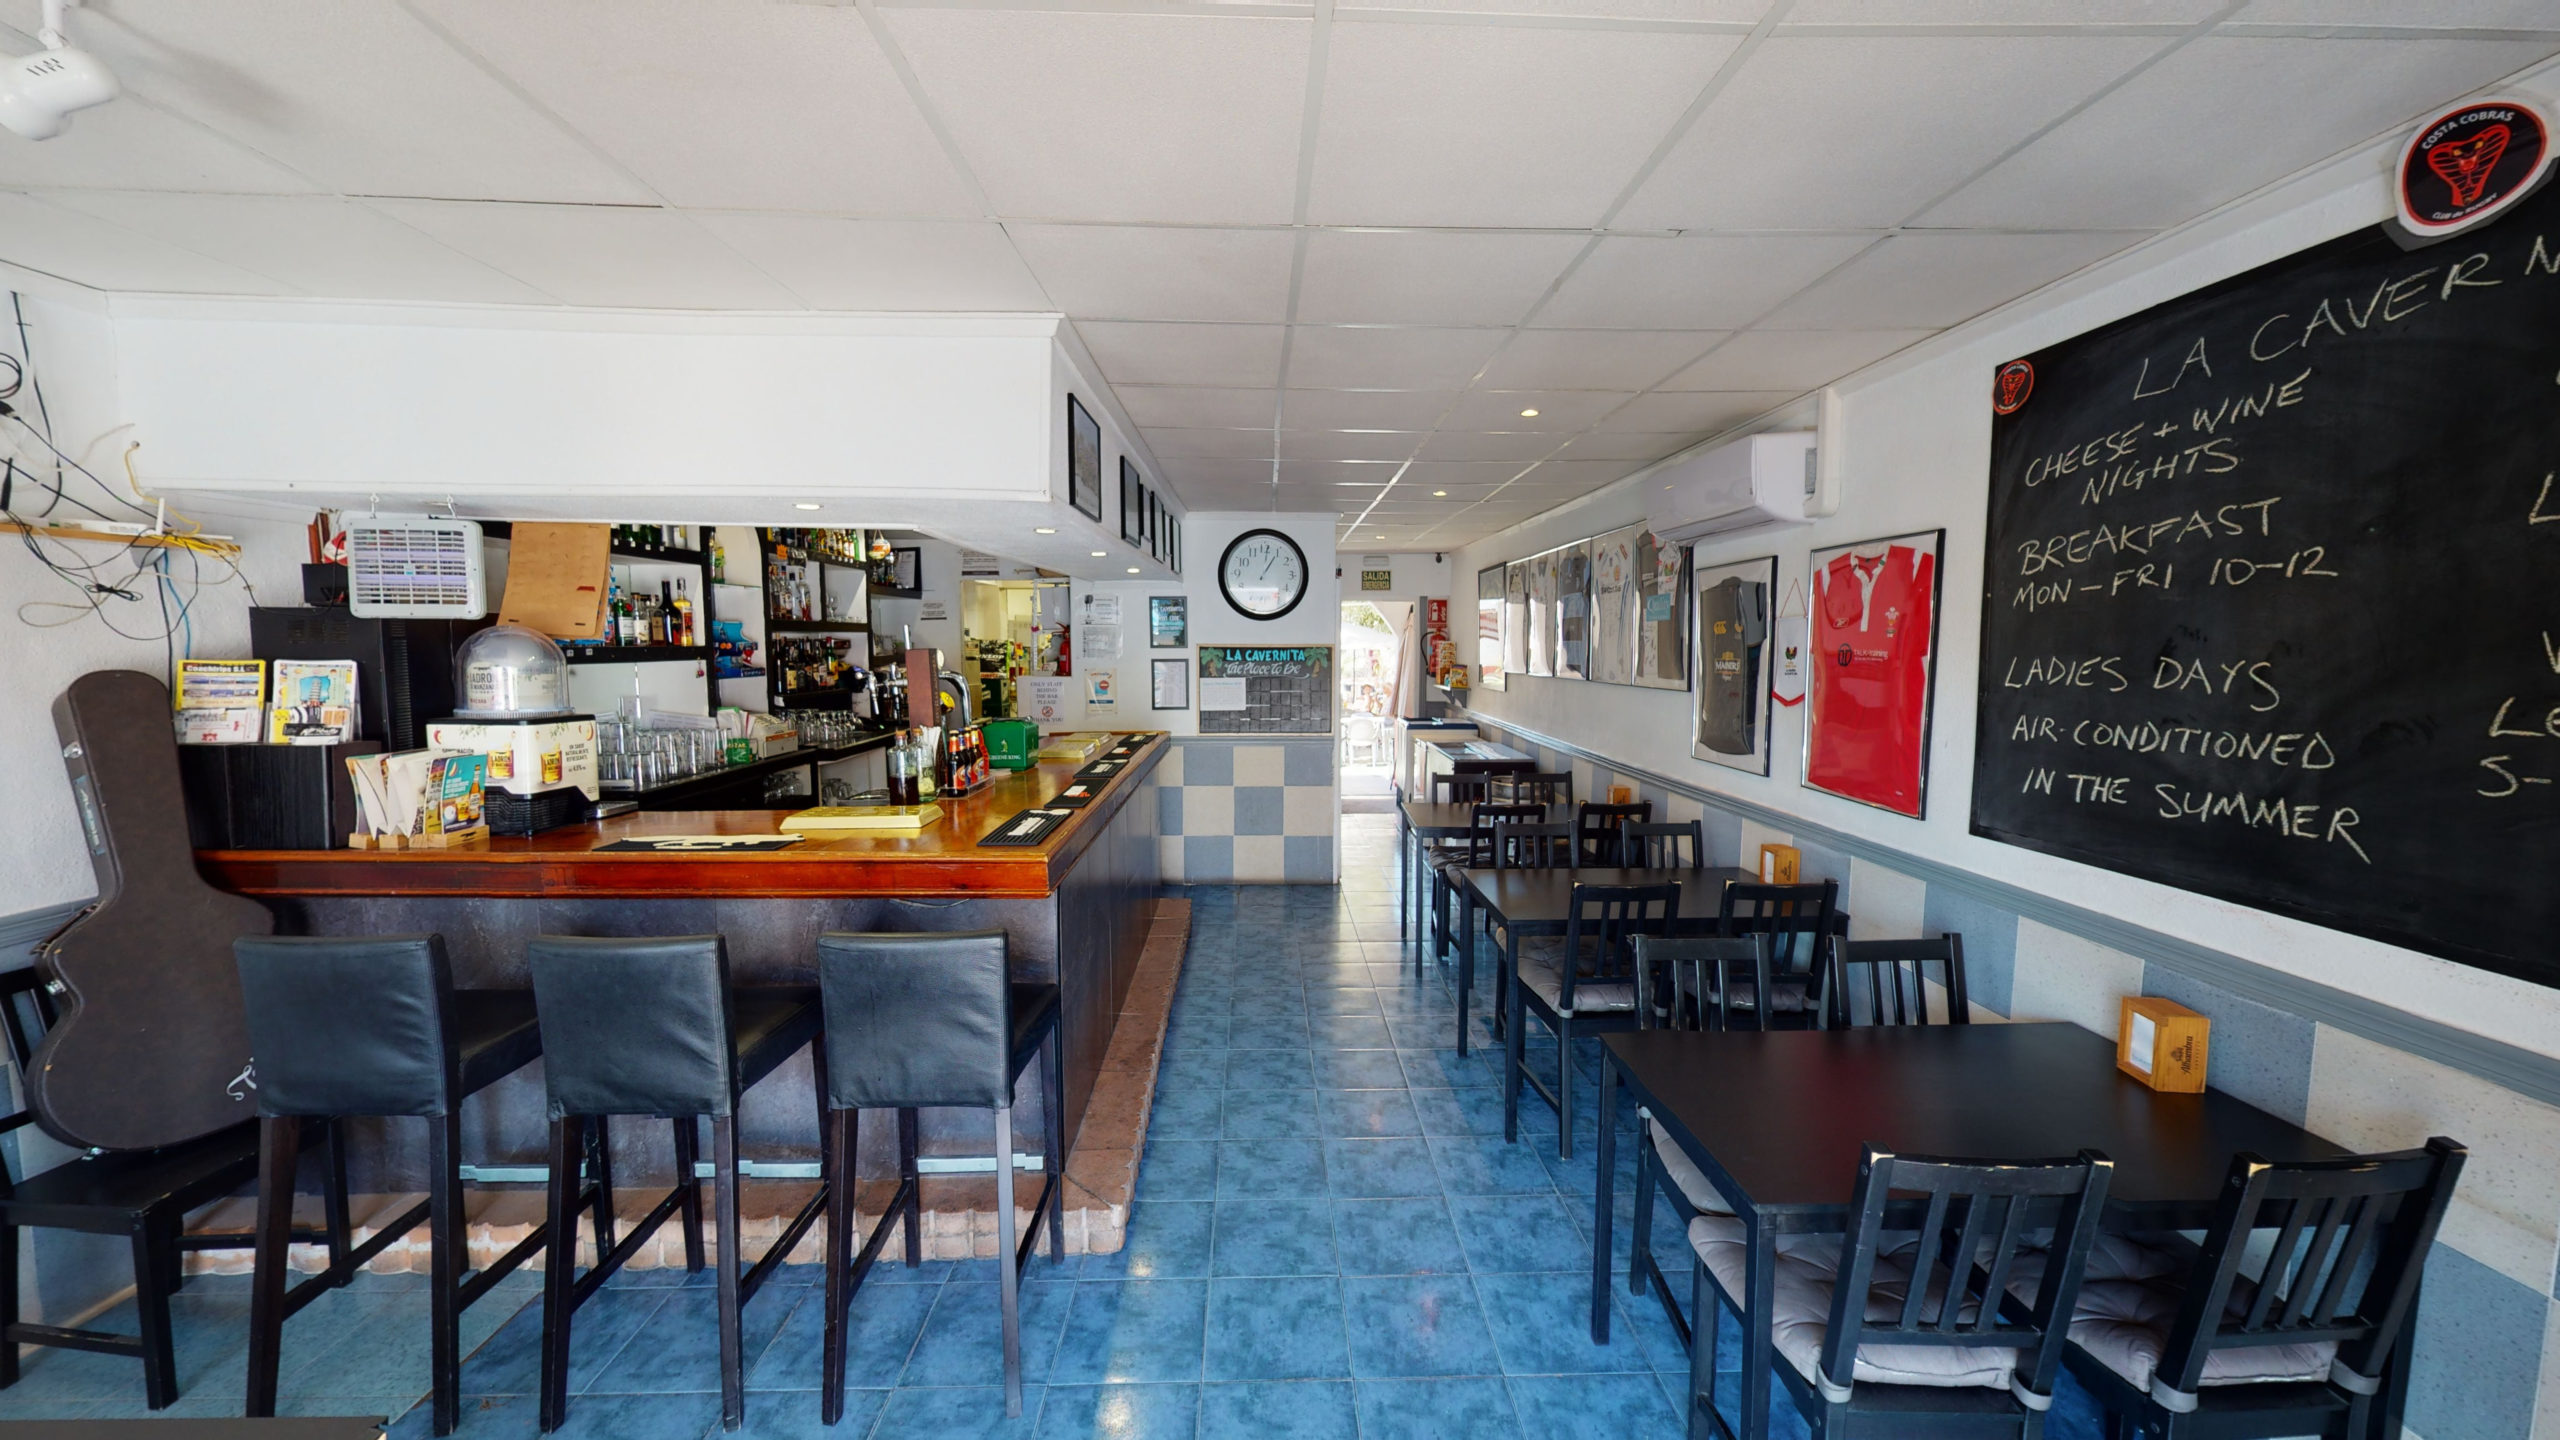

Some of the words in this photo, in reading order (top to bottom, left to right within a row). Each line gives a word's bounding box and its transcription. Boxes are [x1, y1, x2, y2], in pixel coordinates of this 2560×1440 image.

[2421, 121, 2458, 150] COSTA
[2459, 110, 2515, 125] COBRAS
[2133, 336, 2212, 401] LA
[2025, 423, 2144, 488] CHEESE
[2193, 367, 2312, 435] WINE
[2081, 437, 2240, 506] NIGHTS
[1239, 558, 1249, 567] 10
[2017, 496, 2282, 577] BREAKFAST
[1363, 572, 1389, 580] SALIDA
[2209, 546, 2338, 585] 10-12
[1225, 649, 1242, 661] LA
[1245, 649, 1305, 661] CAVERNITA
[2004, 656, 2128, 692] LADIES
[2153, 657, 2280, 712] DAYS
[2022, 768, 2056, 796] IN
[2067, 774, 2129, 804] THE
[2154, 783, 2371, 865] SUMMER
